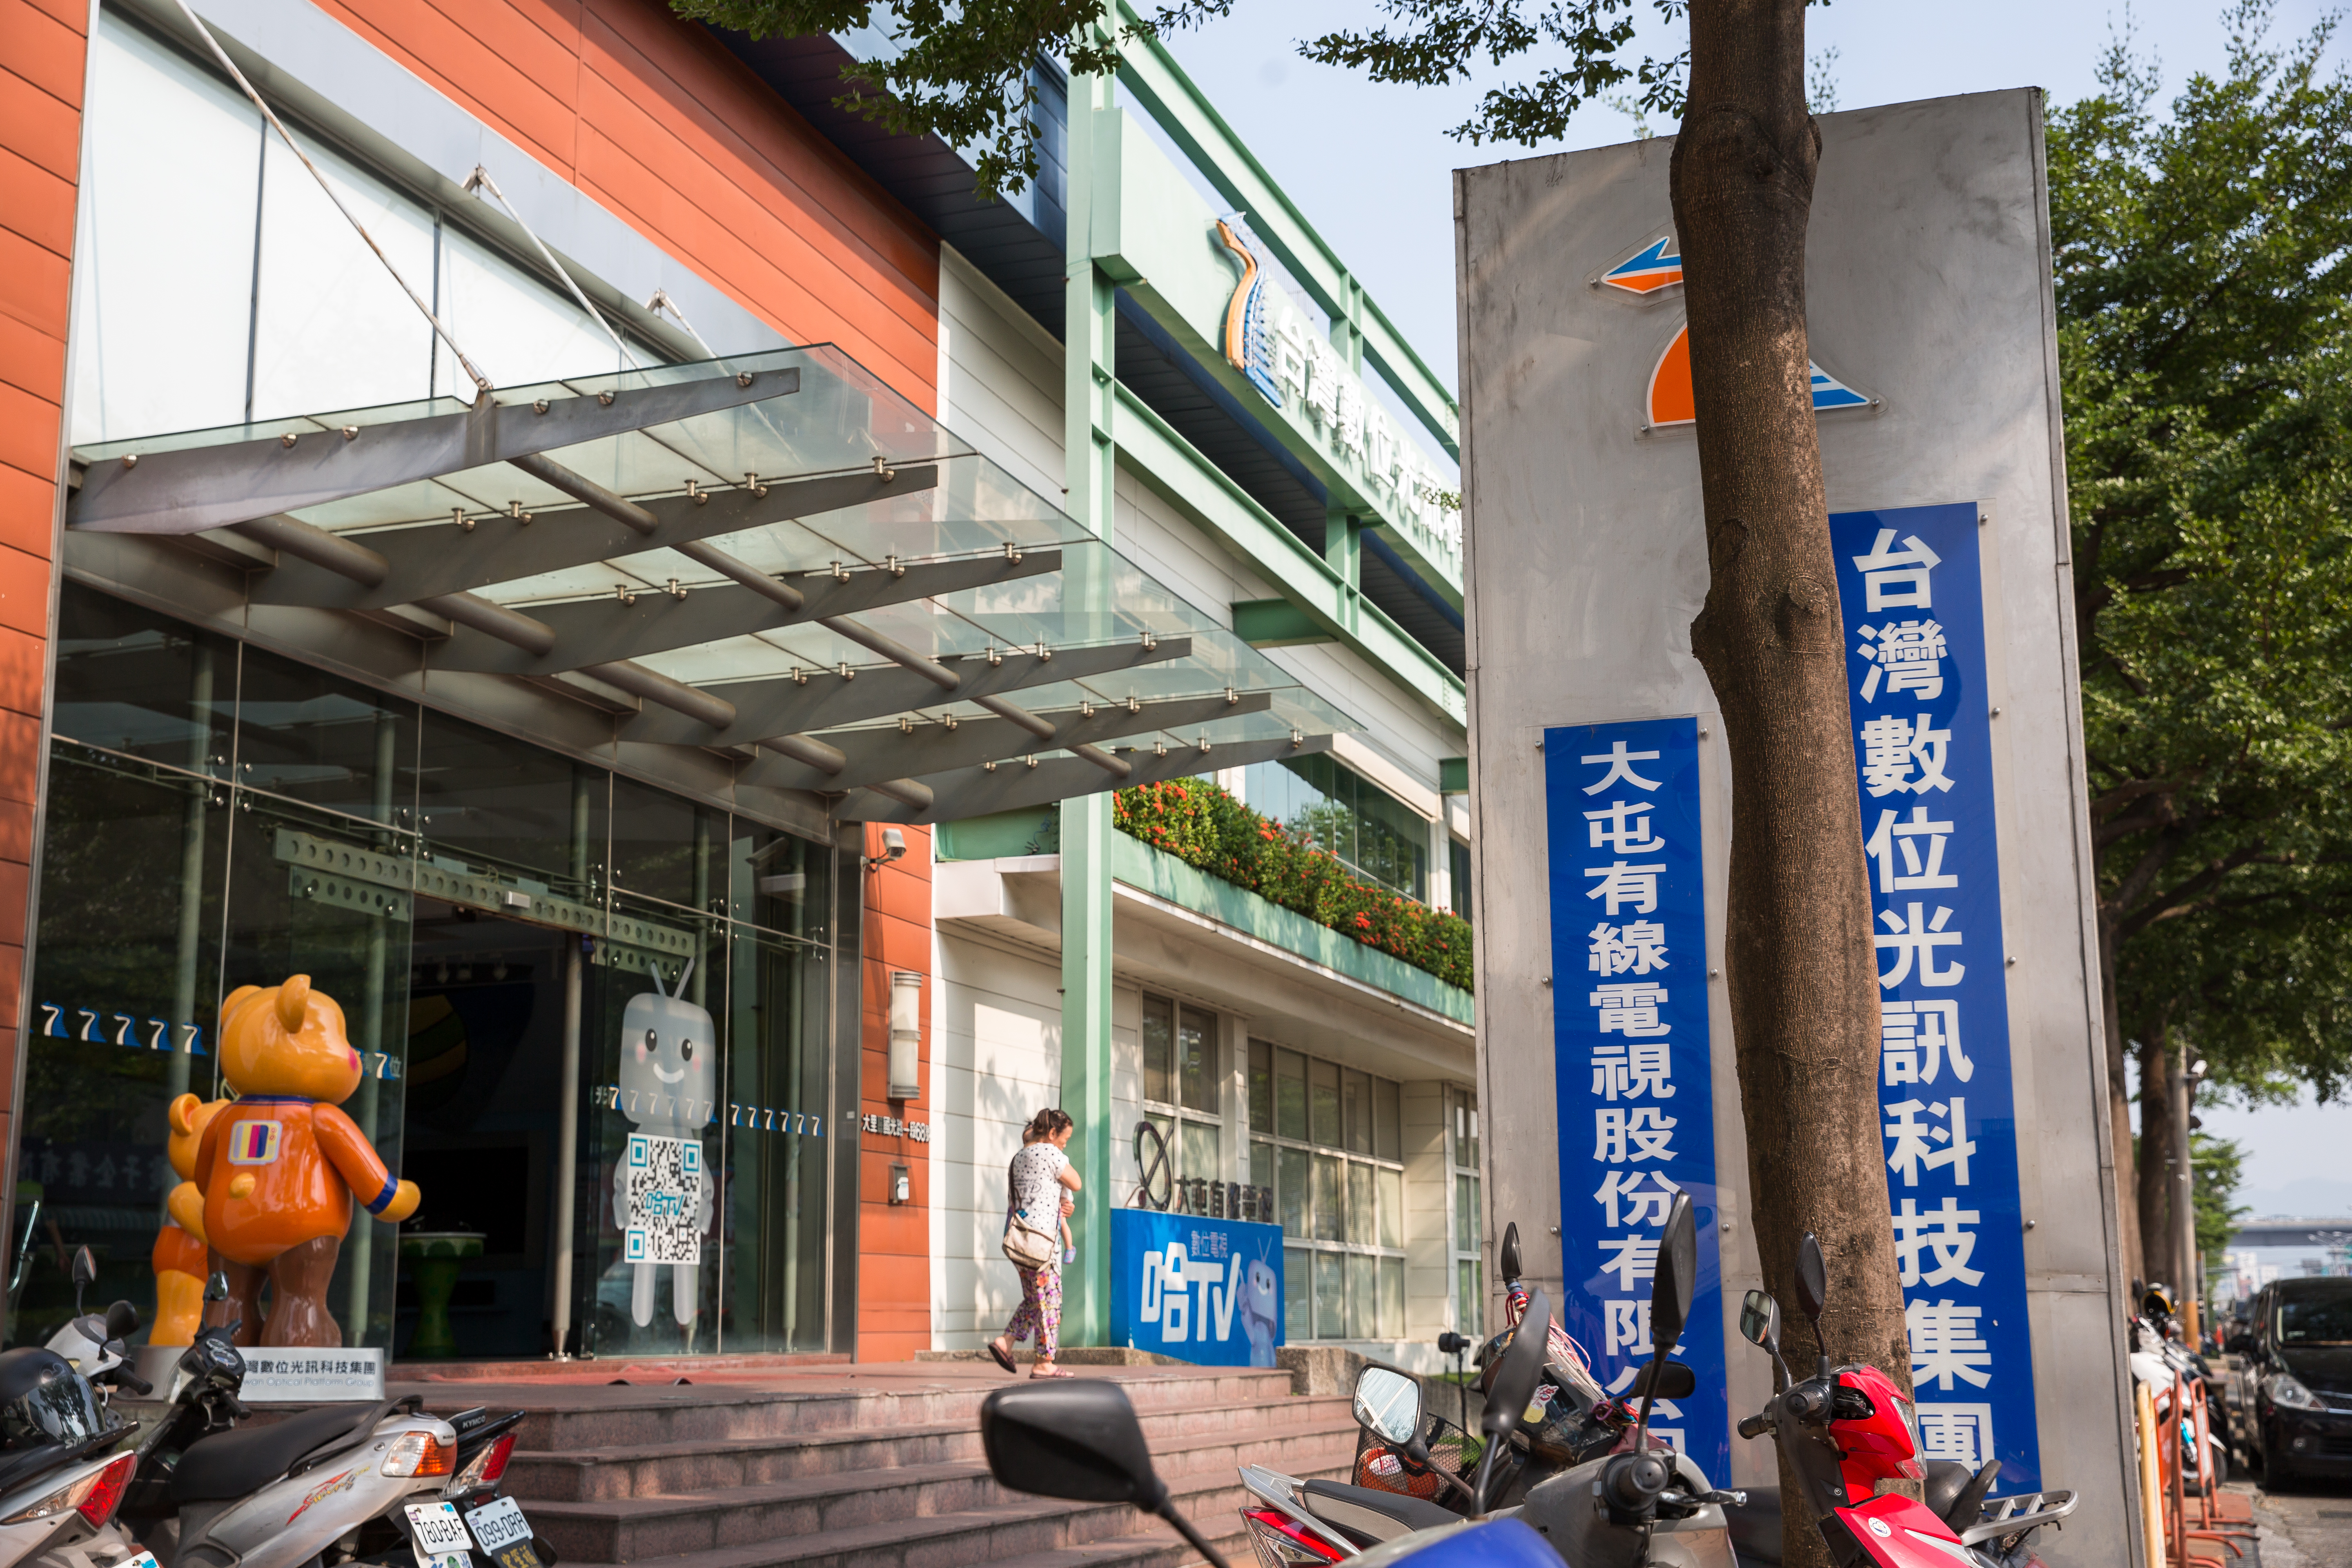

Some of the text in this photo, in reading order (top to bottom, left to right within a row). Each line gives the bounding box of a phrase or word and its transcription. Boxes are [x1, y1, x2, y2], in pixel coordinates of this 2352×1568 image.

[1852, 528, 1996, 1492] 台灣數位光訊科技集團
[1581, 741, 1687, 1454] 大屯有線電視股份有限
[1140, 1242, 1241, 1343] 哈TV
[266, 1377, 302, 1388] Optical
[304, 1377, 343, 1387] Platform
[345, 1377, 374, 1388] Group
[65, 1436, 87, 1450] SYM
[462, 1415, 486, 1429] KYMCO
